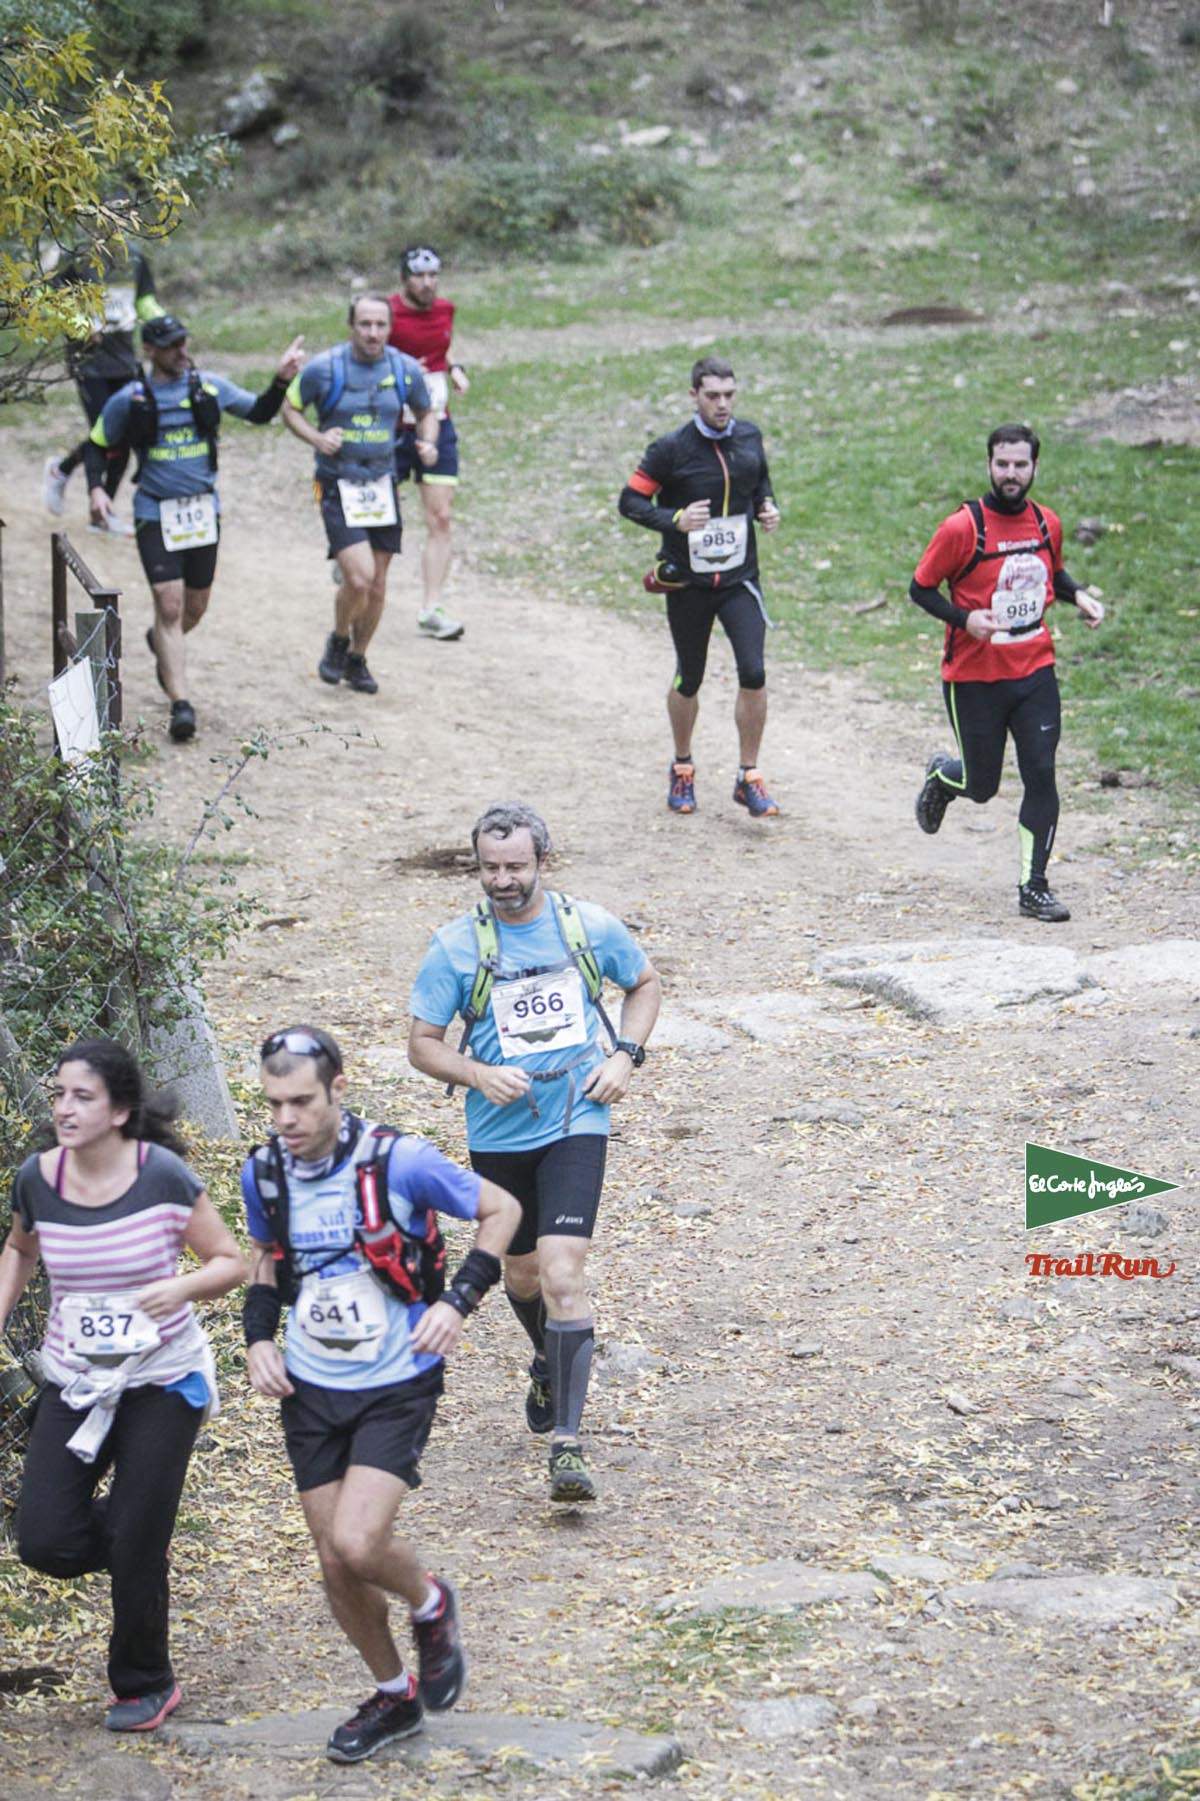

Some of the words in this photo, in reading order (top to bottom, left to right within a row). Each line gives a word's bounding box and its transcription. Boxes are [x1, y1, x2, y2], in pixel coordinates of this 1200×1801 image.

[175, 509, 204, 525] 110
[702, 531, 736, 548] 983
[1006, 600, 1037, 619] 984
[513, 992, 564, 1018] 966
[309, 1300, 361, 1323] 641
[80, 1314, 133, 1337] 837
